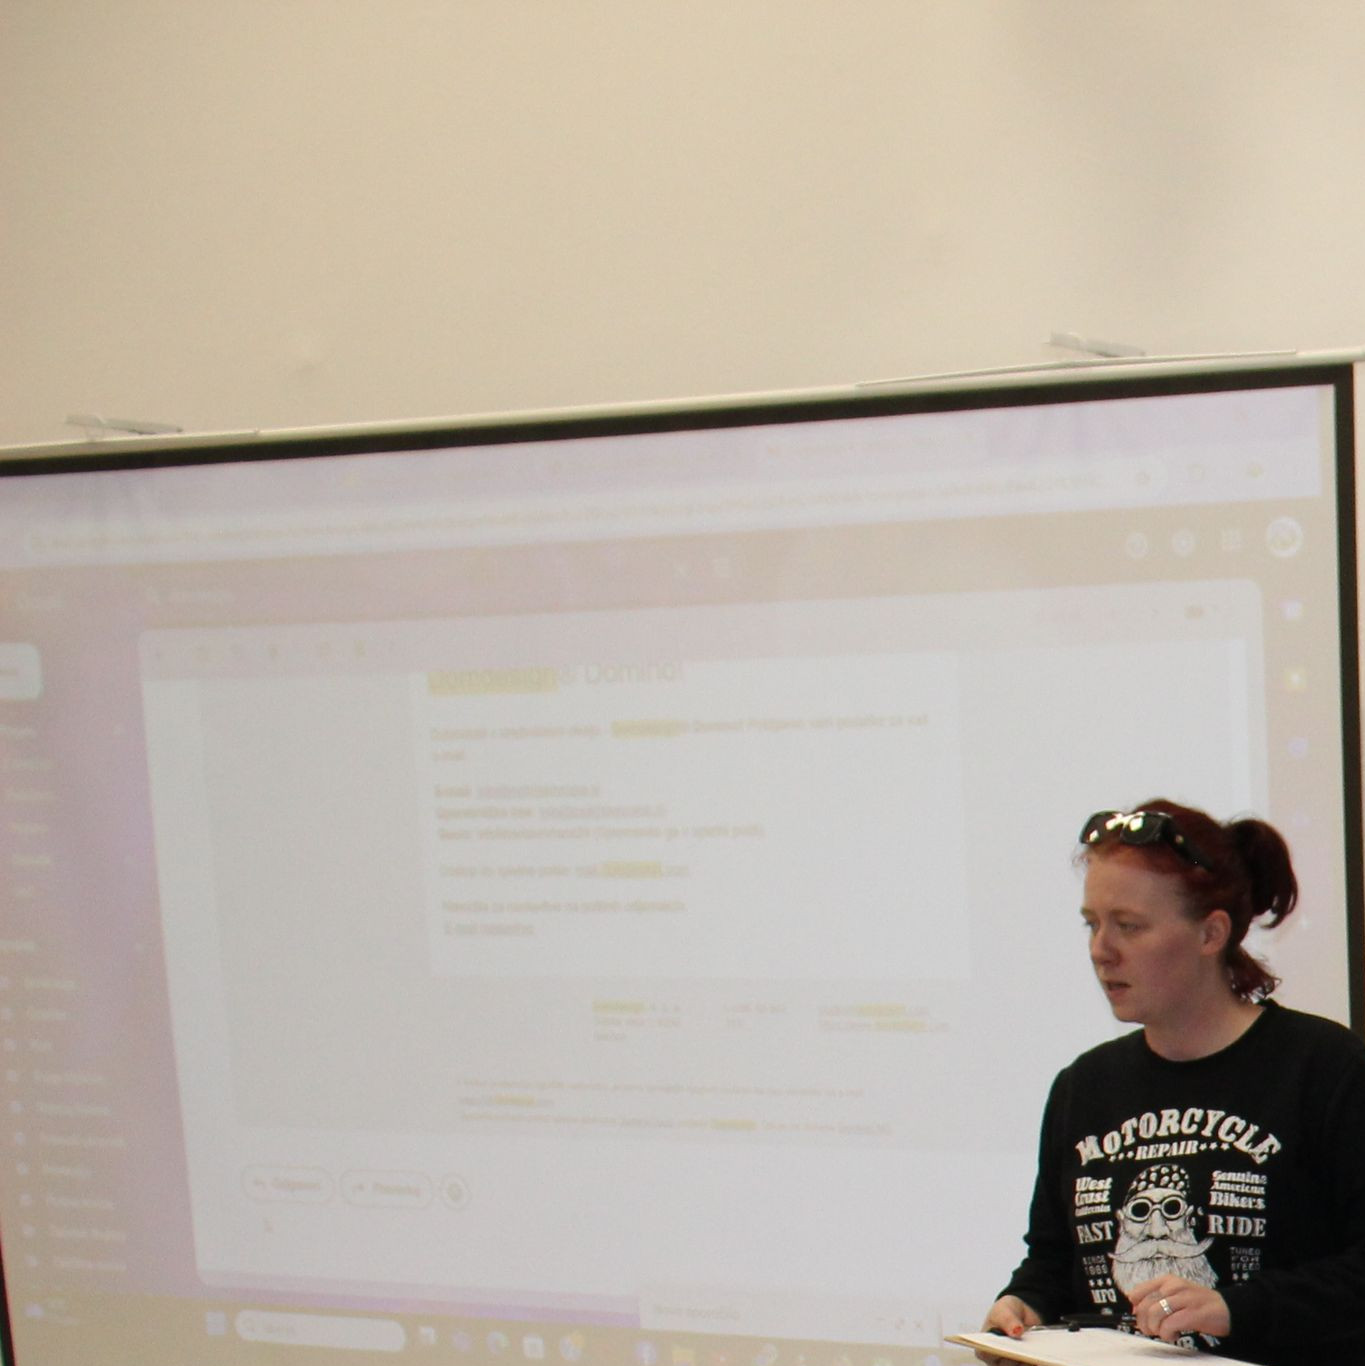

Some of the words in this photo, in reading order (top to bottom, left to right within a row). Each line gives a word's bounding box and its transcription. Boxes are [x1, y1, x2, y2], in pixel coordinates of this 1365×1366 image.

[1075, 1107, 1282, 1166] MOTORCYCLE
[1135, 1140, 1199, 1161] REPAIR
[1076, 1176, 1113, 1192] West
[1211, 1170, 1268, 1185] Genuine
[1209, 1181, 1266, 1195] American
[1209, 1191, 1266, 1211] Bikers
[1076, 1221, 1114, 1244] FAST
[1207, 1214, 1267, 1238] RIDE
